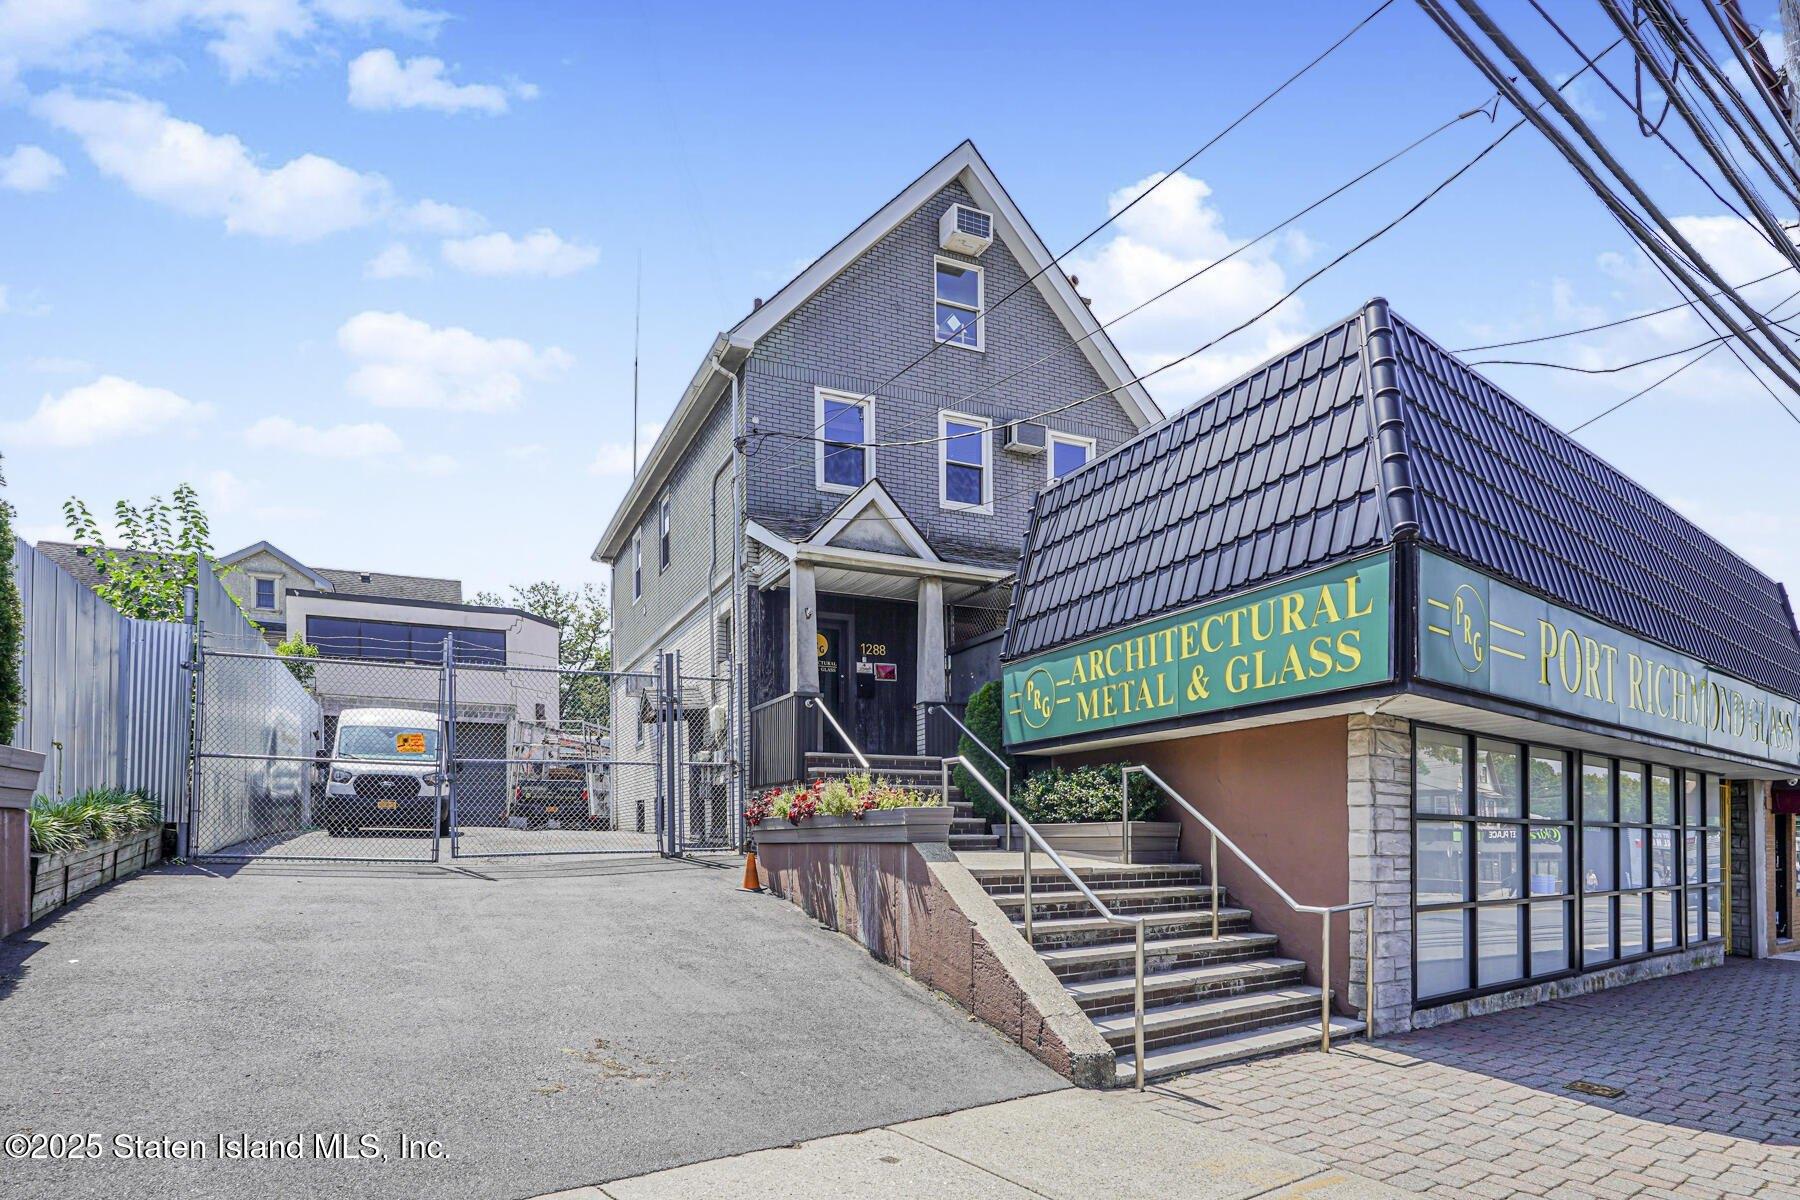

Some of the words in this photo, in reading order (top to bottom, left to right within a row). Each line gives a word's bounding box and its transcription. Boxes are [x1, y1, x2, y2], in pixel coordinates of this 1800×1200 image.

[860, 643, 886, 656] 1288
[1070, 576, 1373, 685] ARCHITECTURAL
[1455, 596, 1483, 663] PRG
[1026, 680, 1051, 719] PRG
[1075, 672, 1175, 723] METAL
[1186, 664, 1210, 702] &
[1224, 629, 1363, 694] GLASS
[1537, 618, 1619, 705] PORT
[1627, 652, 1745, 738] RICHMOND
[1748, 698, 1793, 752] GLASS
